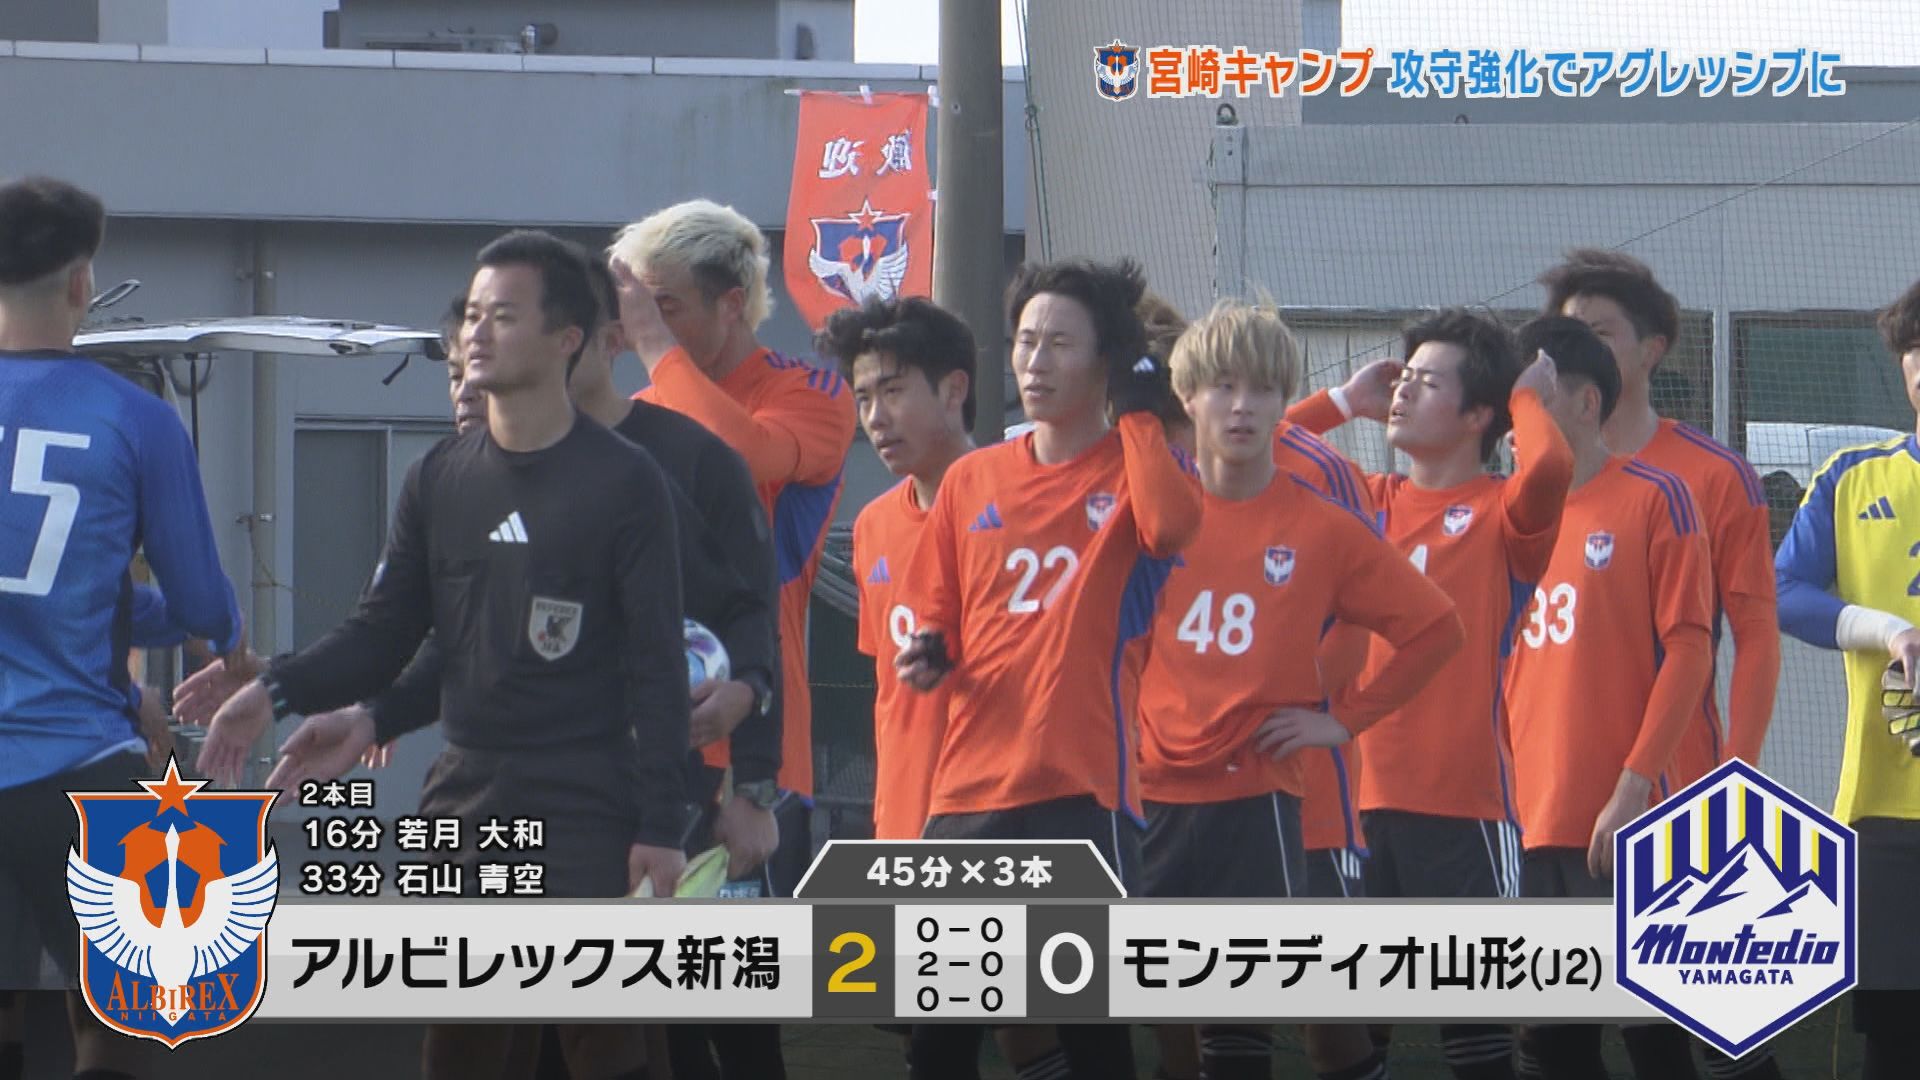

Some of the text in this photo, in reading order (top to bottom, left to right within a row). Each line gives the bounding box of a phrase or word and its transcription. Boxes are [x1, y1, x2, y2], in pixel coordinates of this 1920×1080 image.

[0, 426, 92, 596] 5
[1005, 545, 1079, 614] 22
[1177, 589, 1256, 656] 48
[1522, 583, 1577, 649] 33
